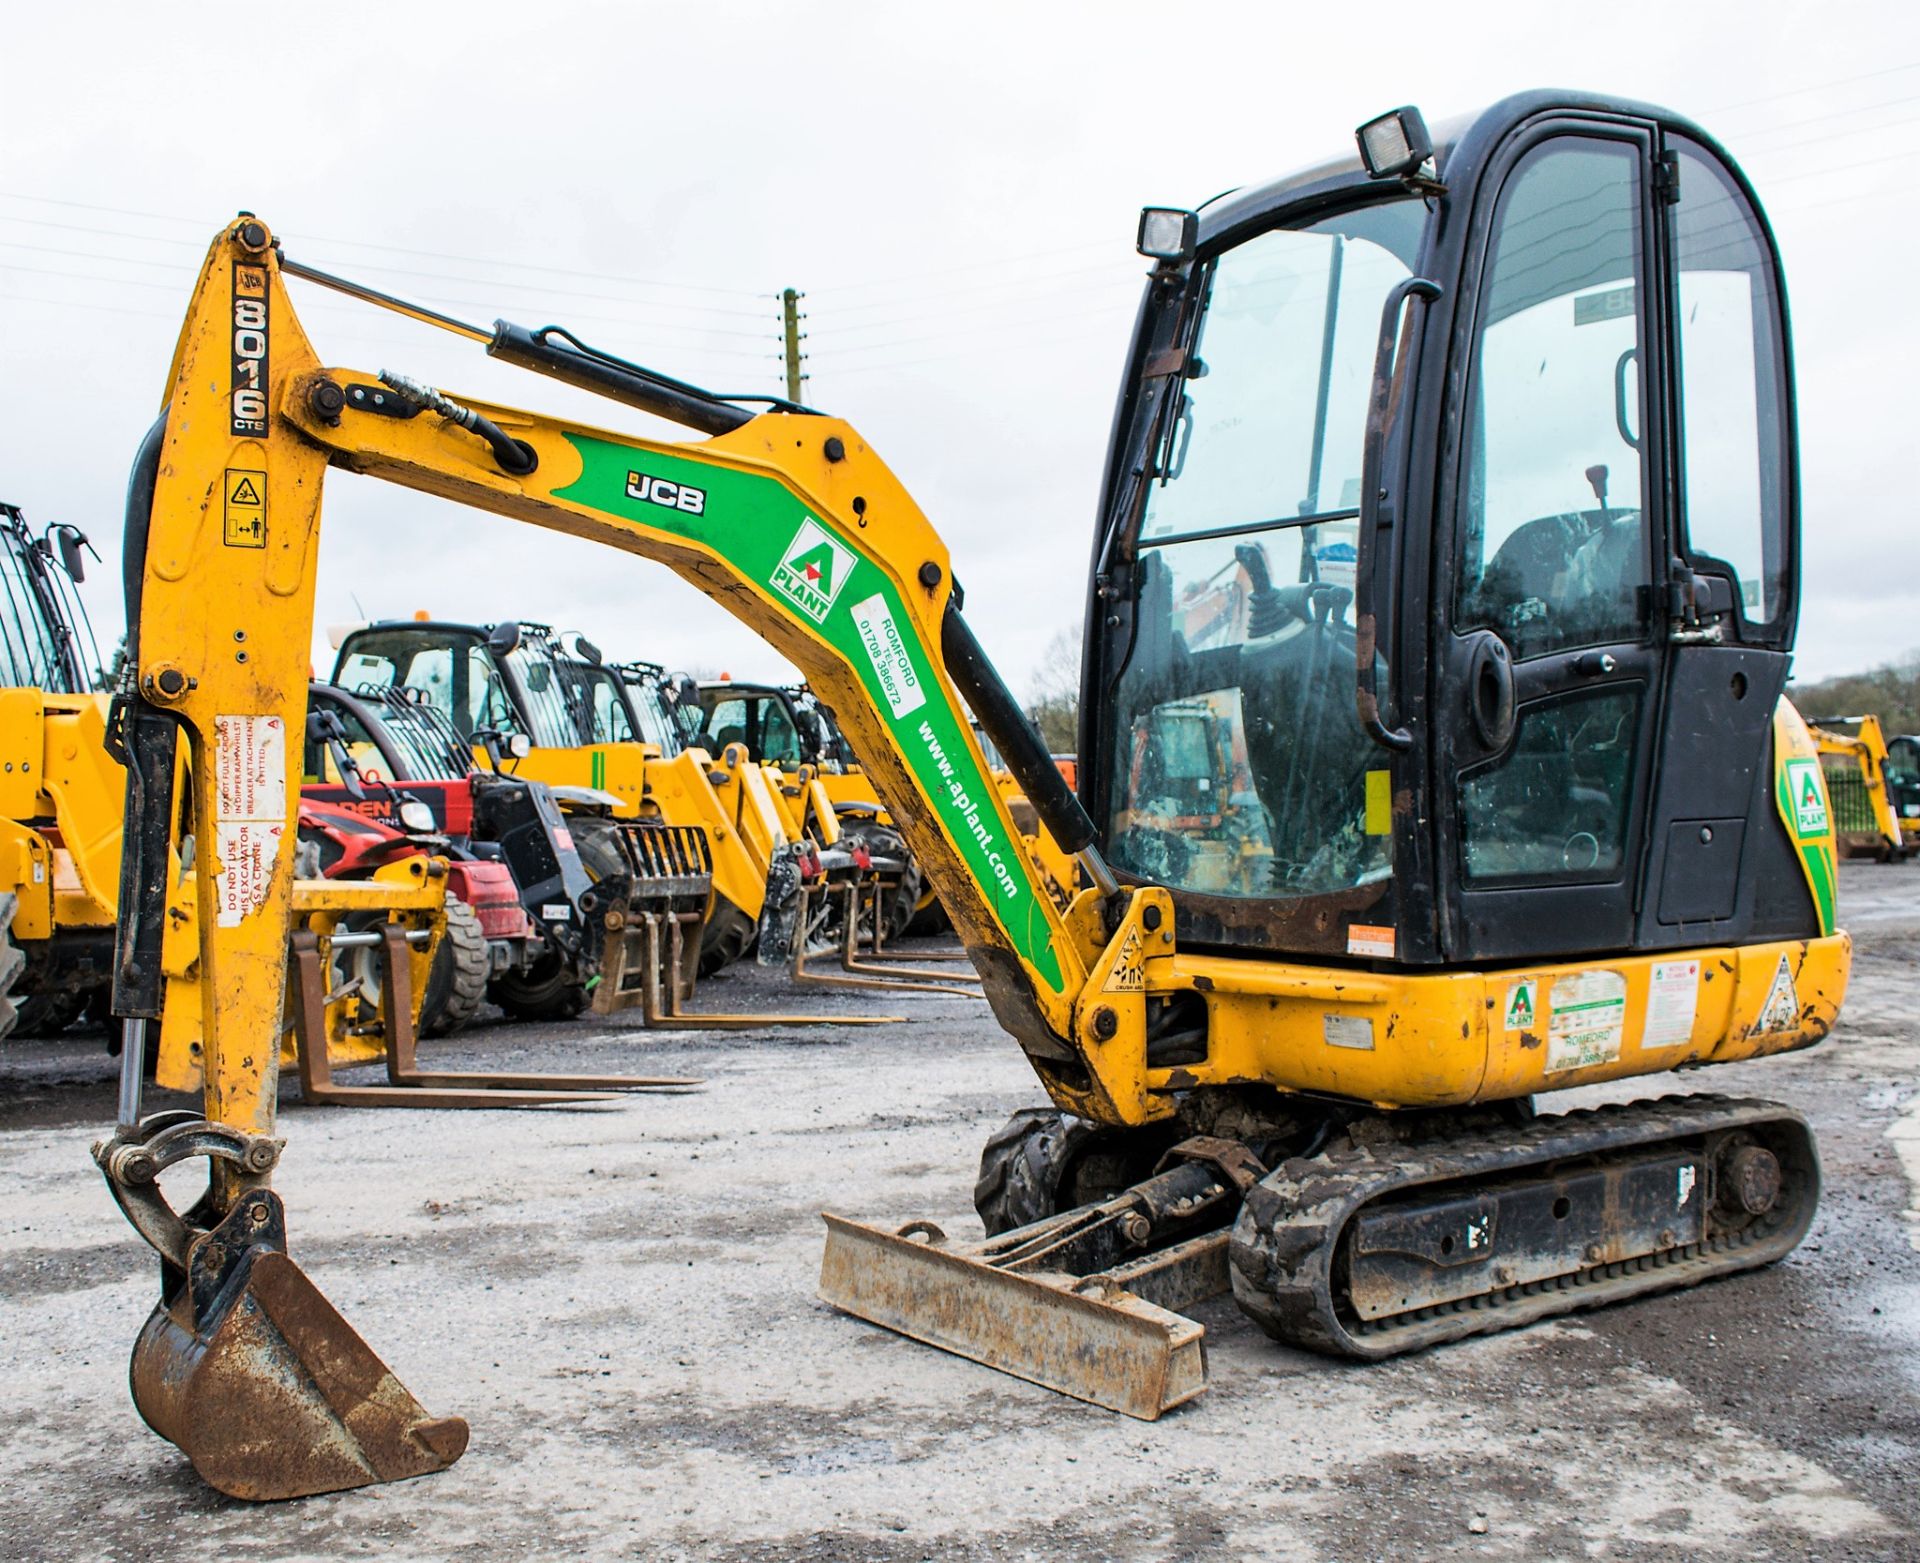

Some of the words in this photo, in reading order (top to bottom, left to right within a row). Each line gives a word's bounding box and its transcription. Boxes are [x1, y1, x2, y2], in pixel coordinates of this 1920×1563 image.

[234, 299, 266, 420] 8016
[234, 419, 265, 431] CTS
[627, 474, 705, 514] JCB
[788, 541, 835, 598] A
[773, 566, 829, 617] PLANT
[860, 620, 882, 659] 01708
[877, 660, 902, 706] 386672
[881, 618, 916, 688] ROMFORD
[222, 755, 230, 779] FULLY
[246, 720, 254, 777] ATTACHMENT
[246, 780, 254, 815] BREAKER
[1801, 771, 1822, 807] A
[918, 720, 1018, 899] www.aplant.com
[1800, 812, 1826, 826] PLANT
[227, 840, 236, 862] USE
[240, 826, 249, 894] EXCAVATOR
[228, 865, 237, 890] NOT
[228, 893, 237, 911] DO
[1510, 985, 1532, 1014] A
